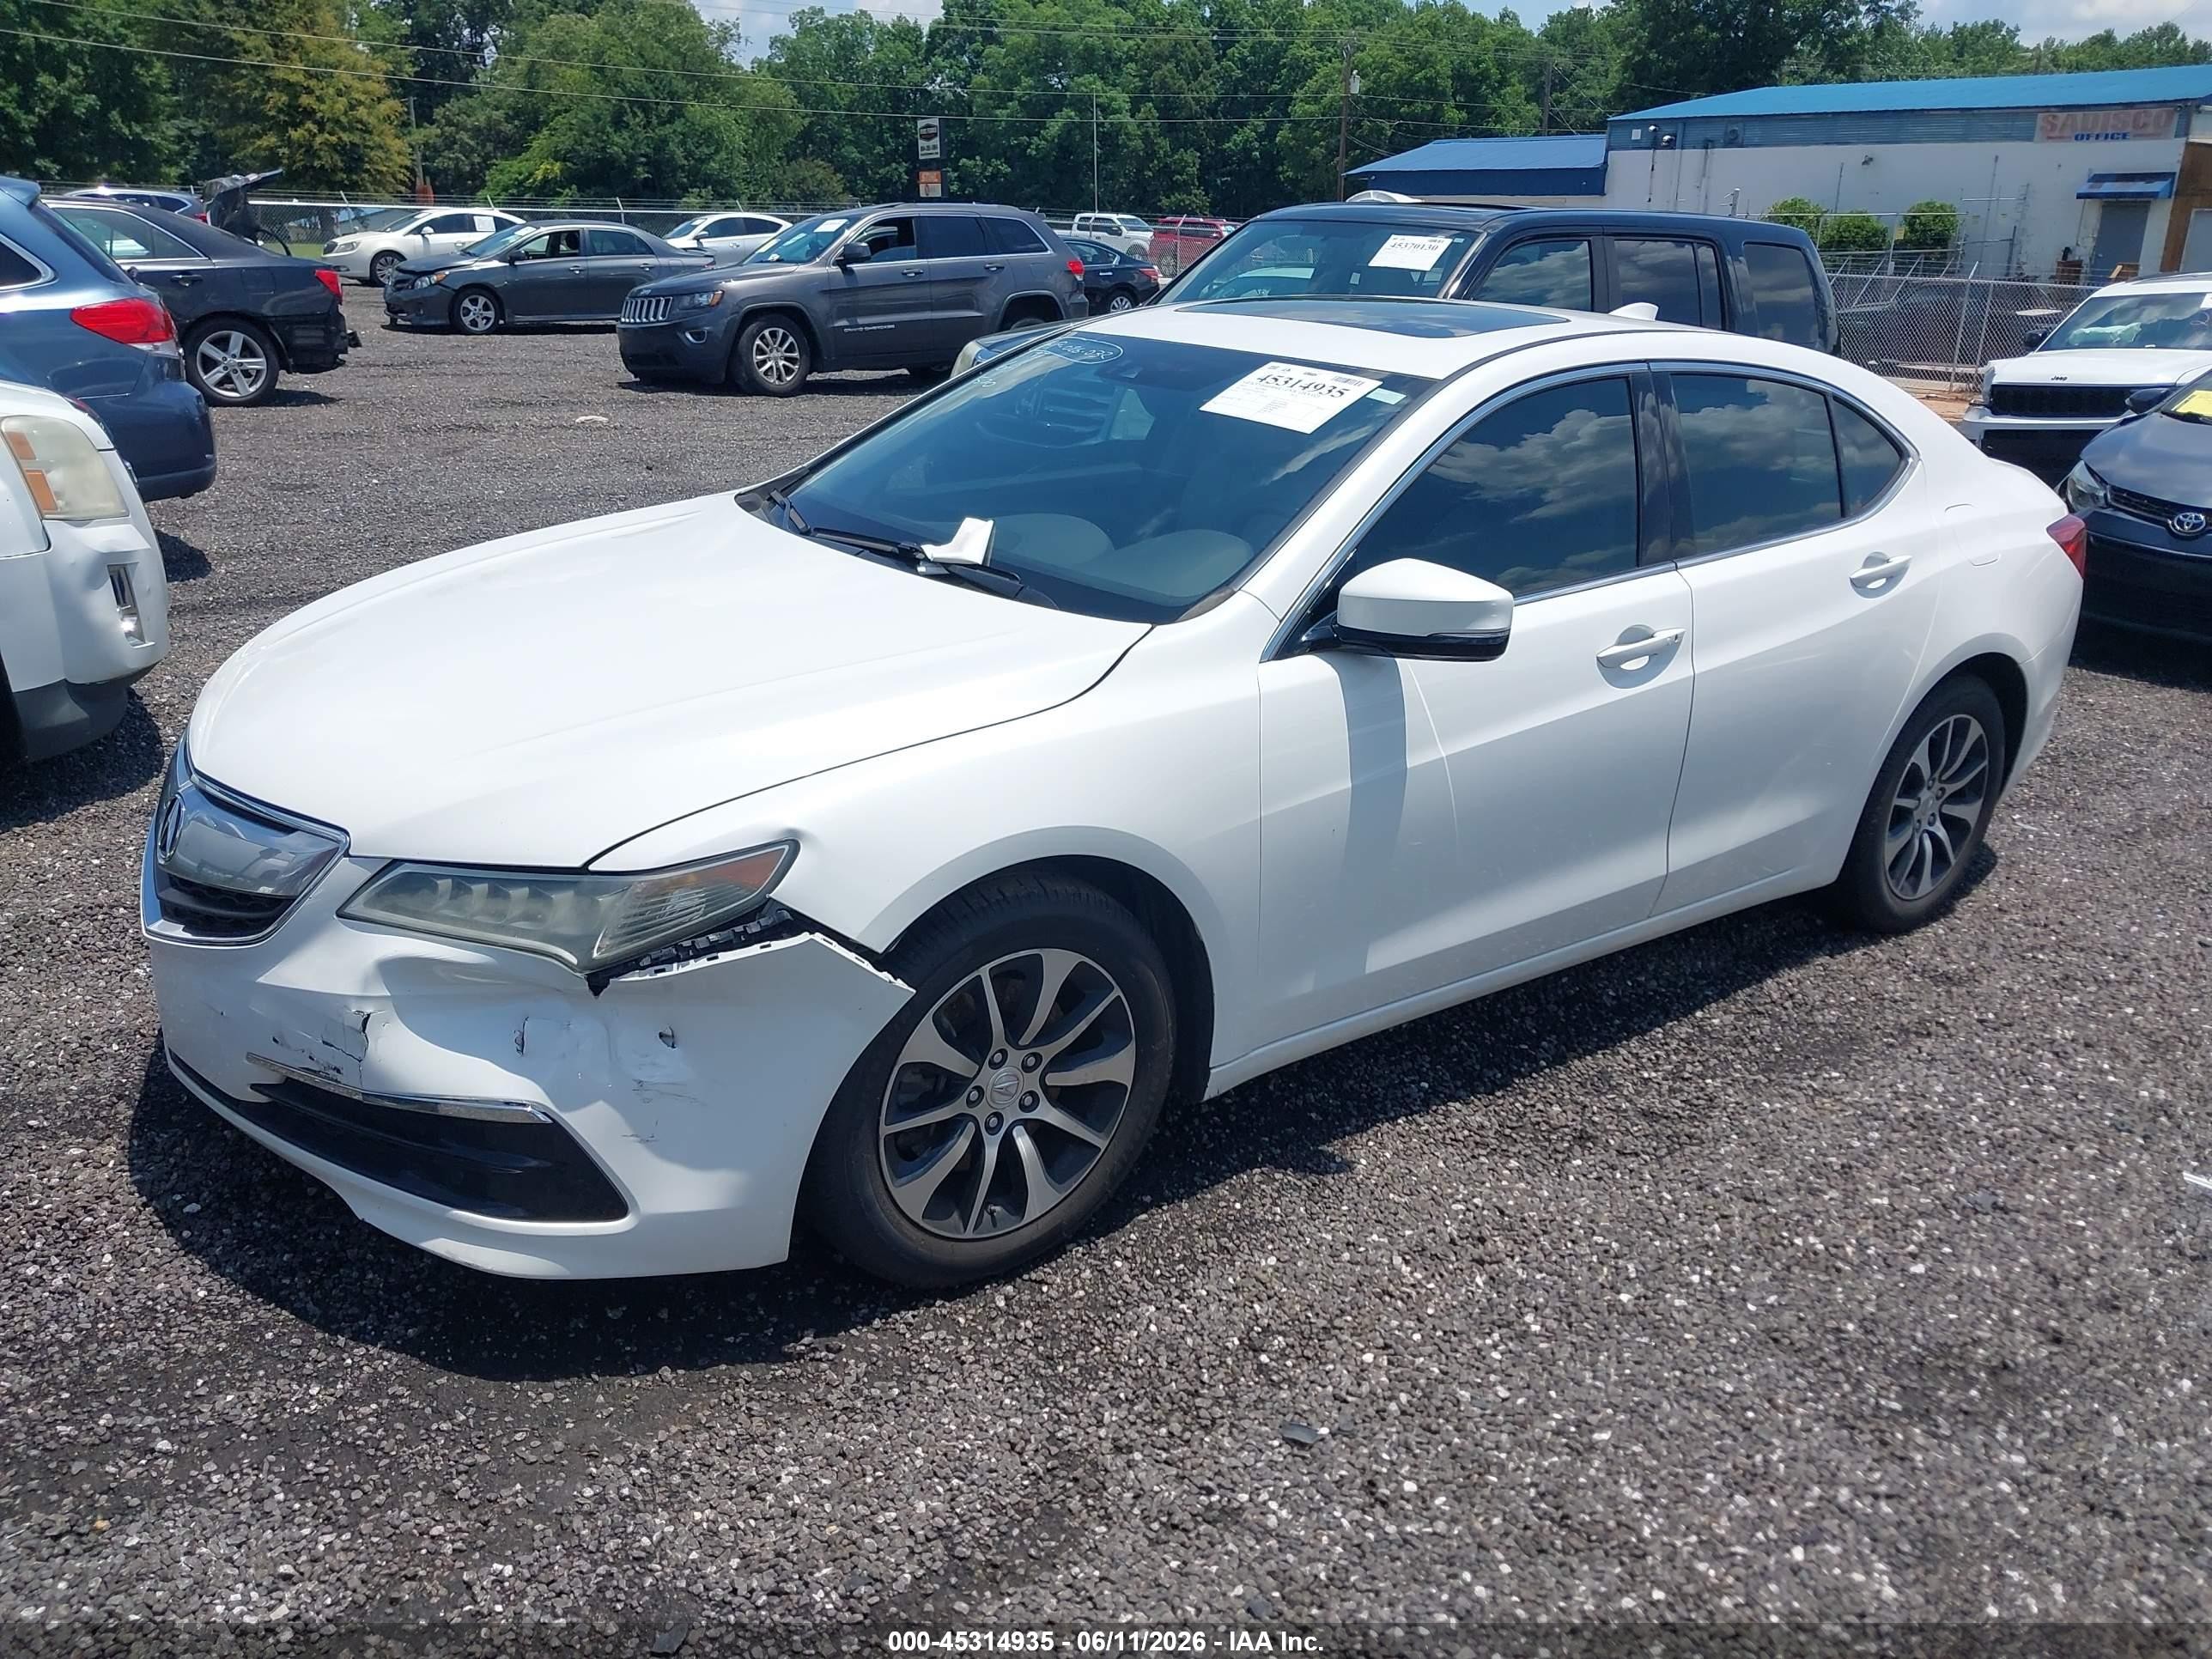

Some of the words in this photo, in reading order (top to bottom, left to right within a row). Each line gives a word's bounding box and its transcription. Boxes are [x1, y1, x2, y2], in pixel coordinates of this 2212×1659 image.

[2040, 110, 2178, 132] SADISCO
[2074, 131, 2130, 142] OFFICE
[1256, 374, 1352, 398] 45314935
[2050, 374, 2069, 383] Jeep
